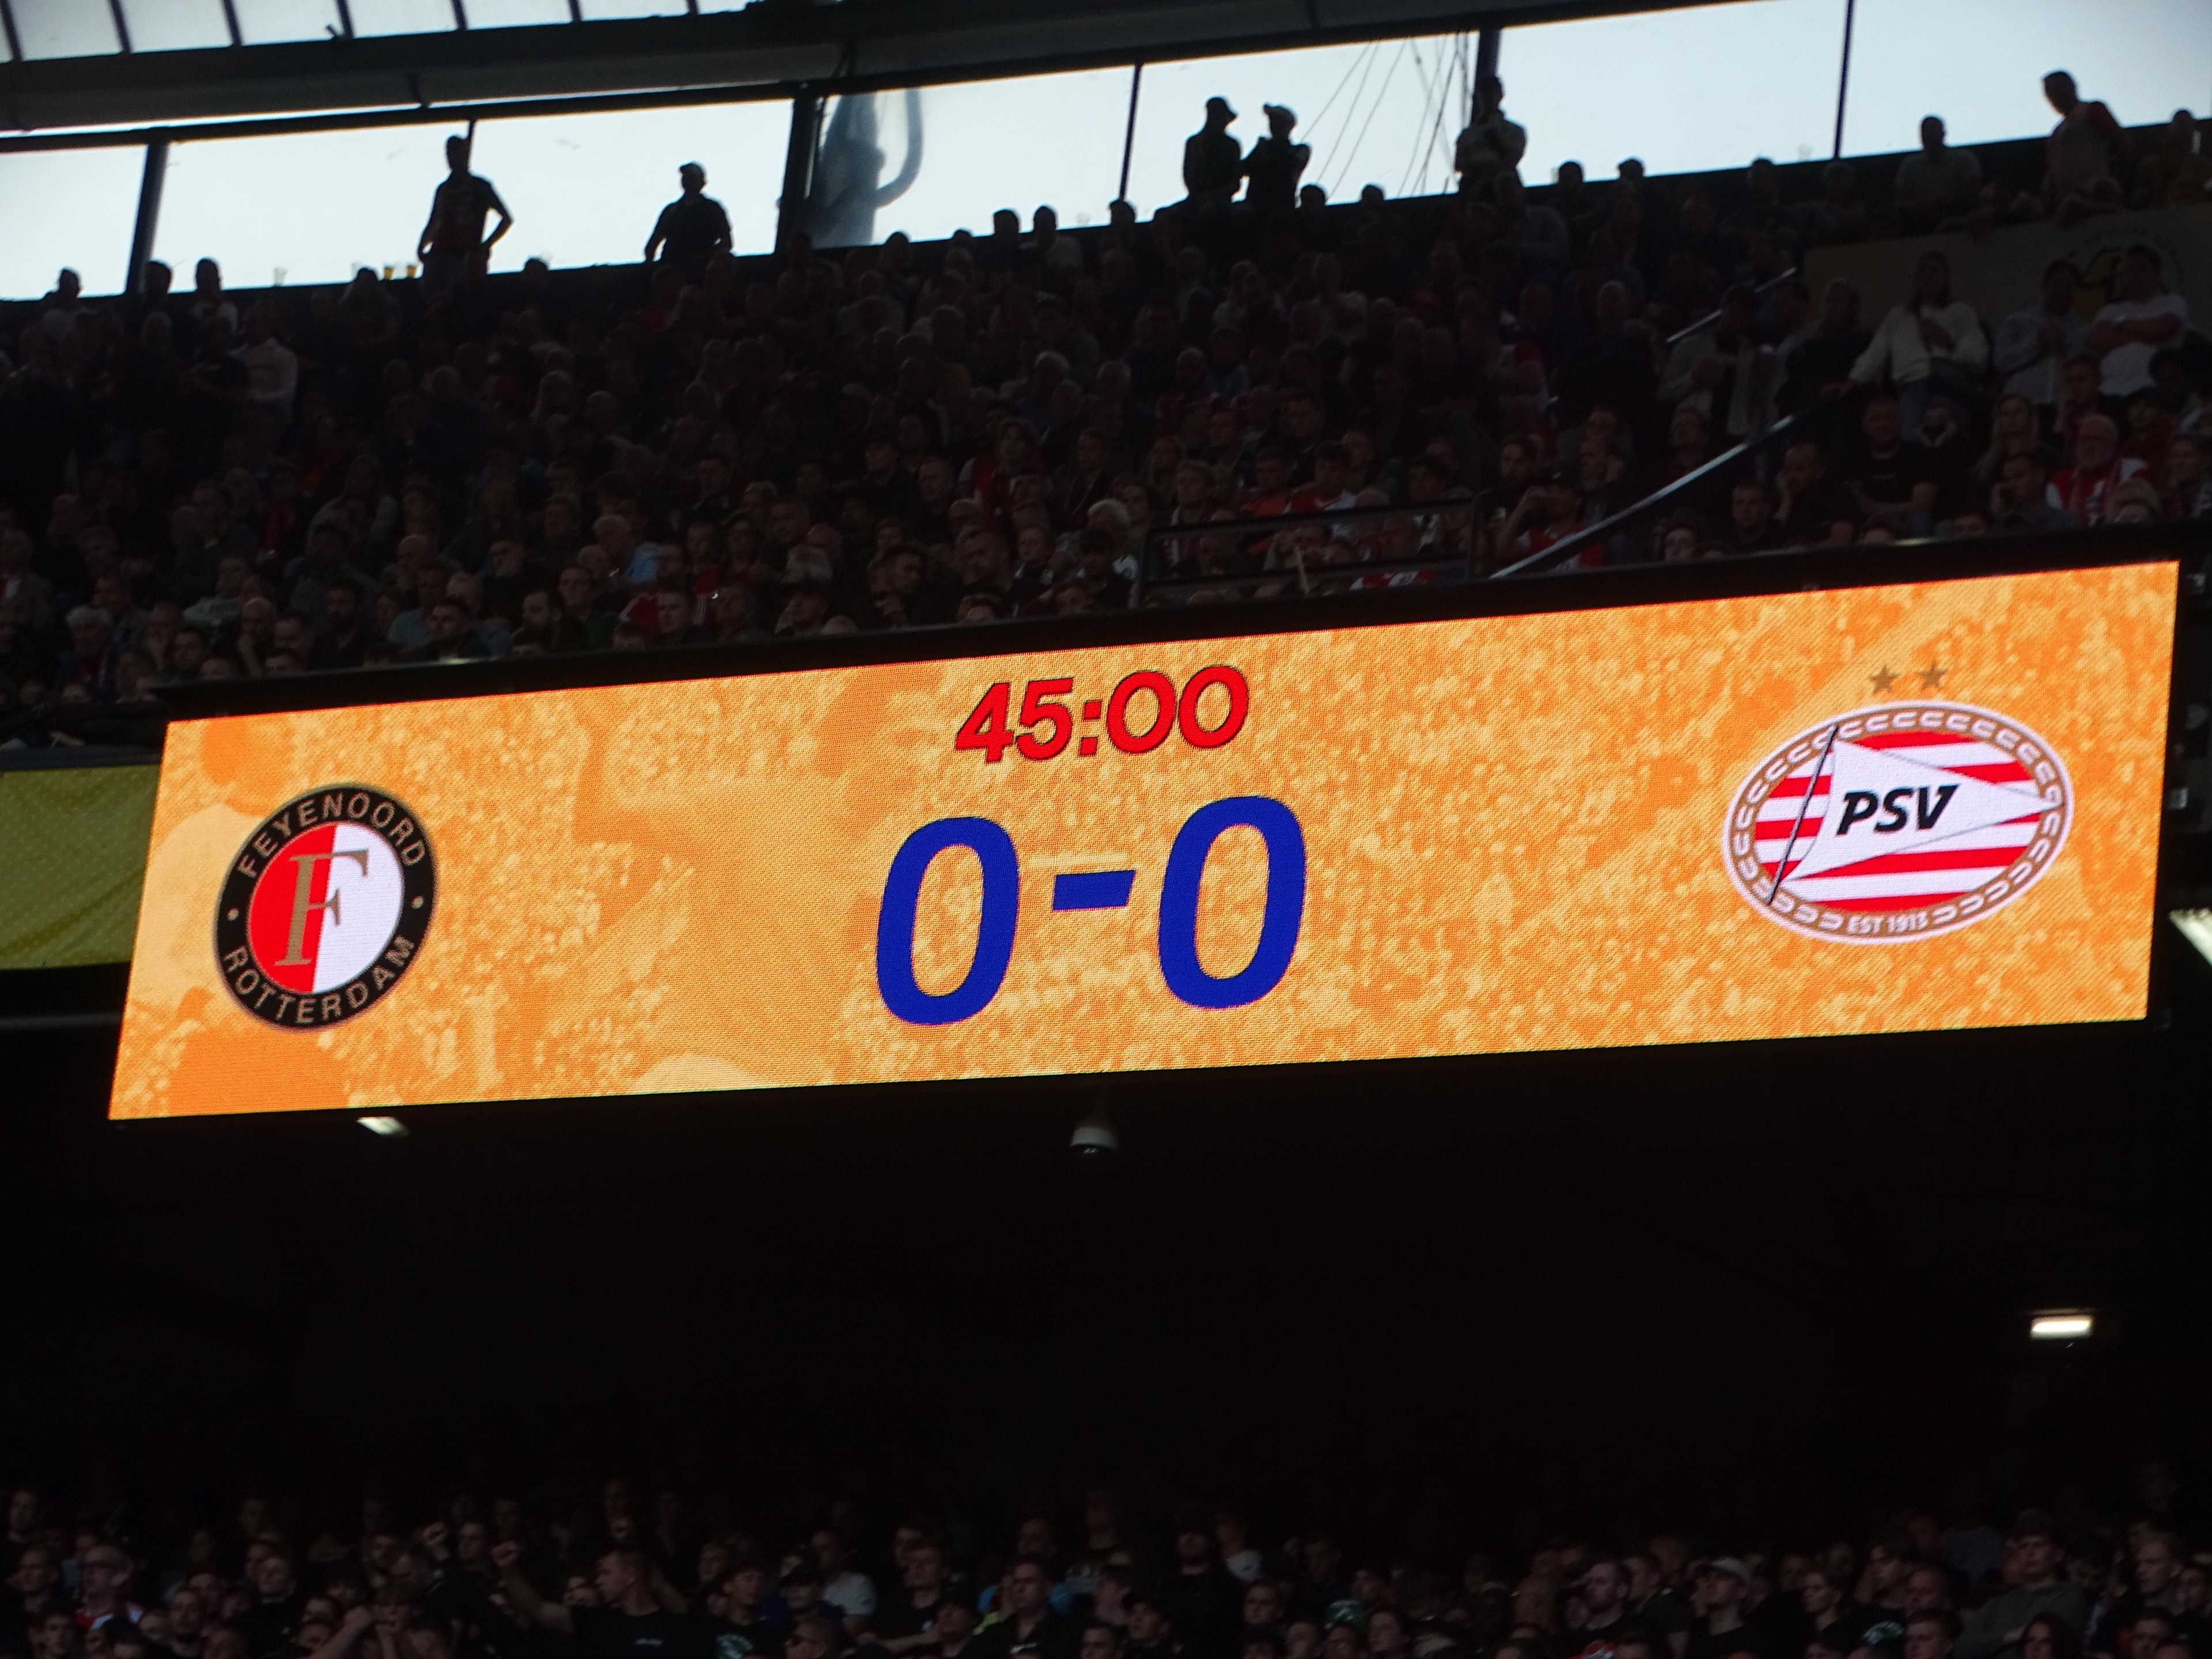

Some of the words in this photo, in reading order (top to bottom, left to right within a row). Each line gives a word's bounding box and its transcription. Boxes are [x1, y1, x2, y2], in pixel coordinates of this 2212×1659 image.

[955, 664, 1249, 763] 45:00
[237, 791, 426, 878] FEYENOORD
[1835, 782, 1961, 836] PSV
[273, 849, 369, 967] F
[1846, 914, 1884, 935] EST
[222, 935, 415, 1024] ROTTERDAM
